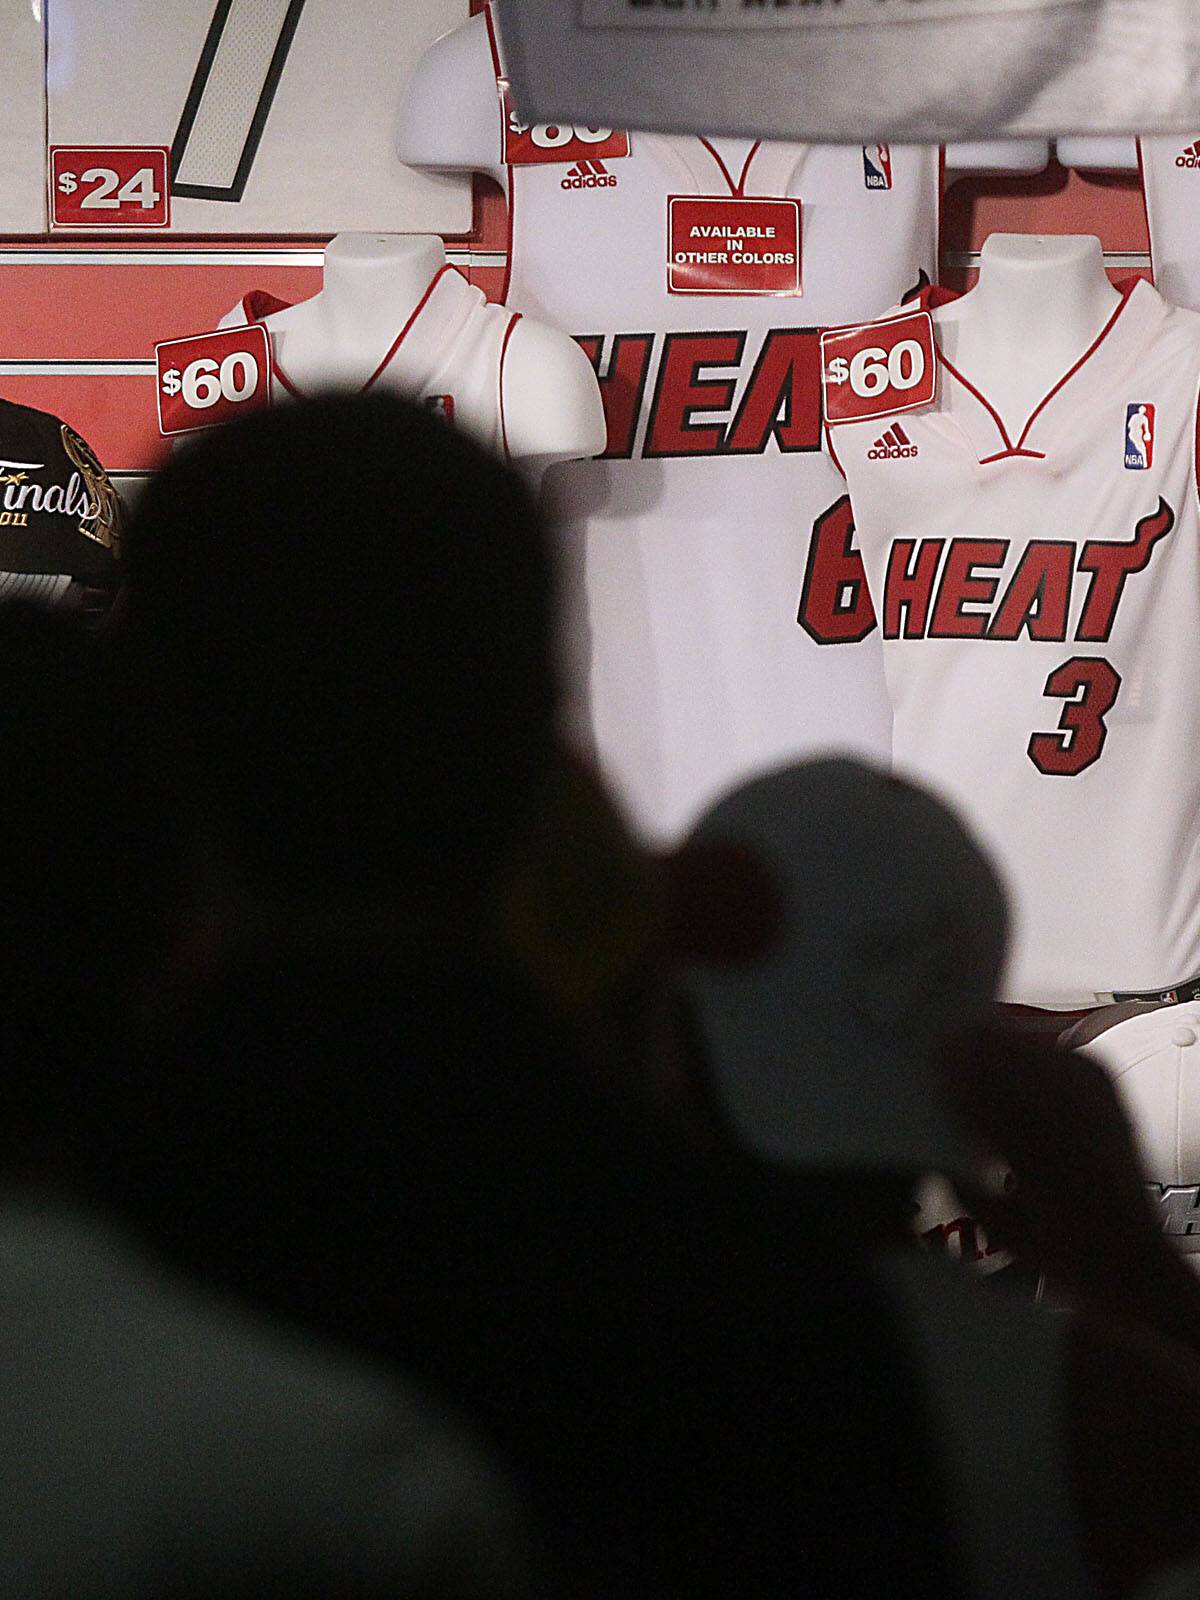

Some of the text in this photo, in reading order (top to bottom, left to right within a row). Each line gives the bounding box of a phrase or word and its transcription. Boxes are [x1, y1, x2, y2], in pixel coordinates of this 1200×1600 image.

[57, 167, 160, 210] $24
[561, 174, 618, 190] adidas
[866, 175, 884, 187] NBA
[690, 226, 776, 239] AVAILABLE
[726, 240, 744, 251] IN
[675, 252, 795, 265] OTHER COLORS
[828, 339, 925, 397] $60
[161, 352, 259, 409] $60
[569, 326, 828, 460] HEA
[867, 442, 919, 460] adidas
[1125, 454, 1144, 467] NBA
[0, 511, 28, 527] 011
[796, 494, 878, 645] 6
[882, 494, 1175, 643] HEAT
[1026, 656, 1122, 776] 3
